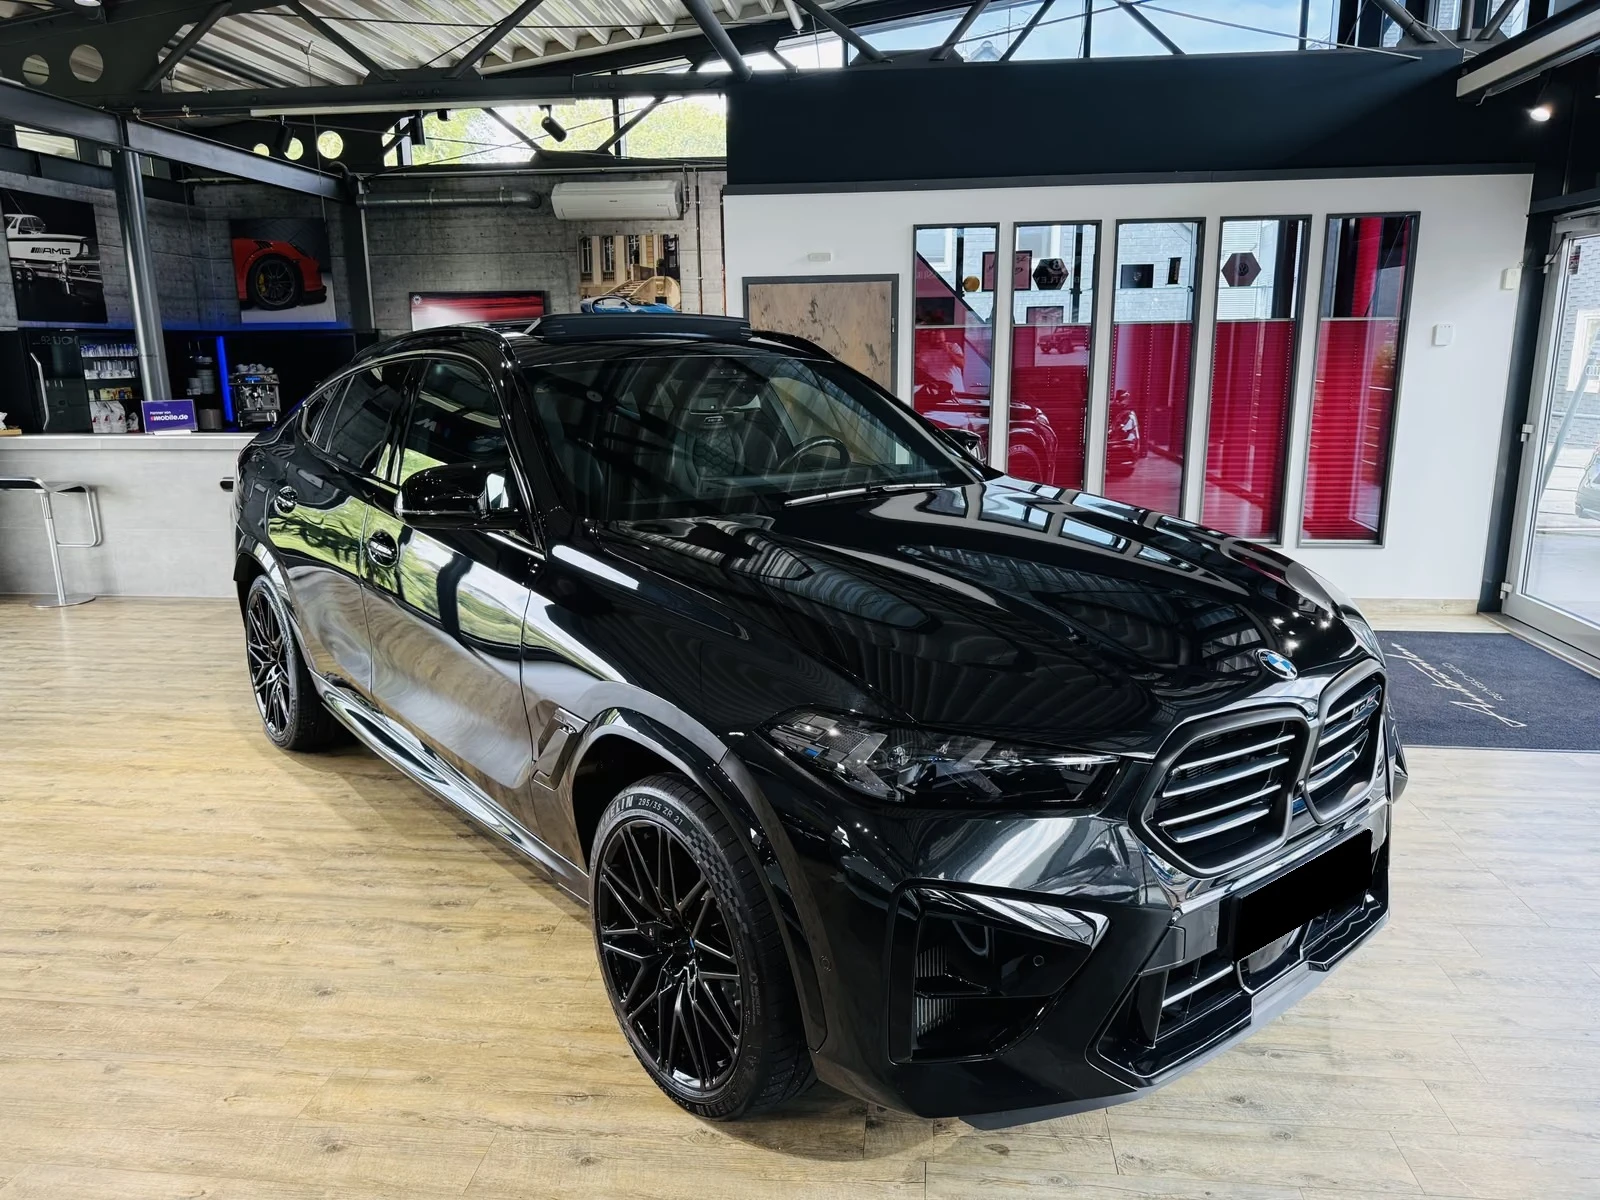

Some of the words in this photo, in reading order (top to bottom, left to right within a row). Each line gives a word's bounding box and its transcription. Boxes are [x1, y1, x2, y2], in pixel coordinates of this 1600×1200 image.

[43, 247, 71, 255] AMG
[638, 798, 662, 811] 295/35
[662, 807, 673, 818] ZR
[674, 815, 683, 826] 21
